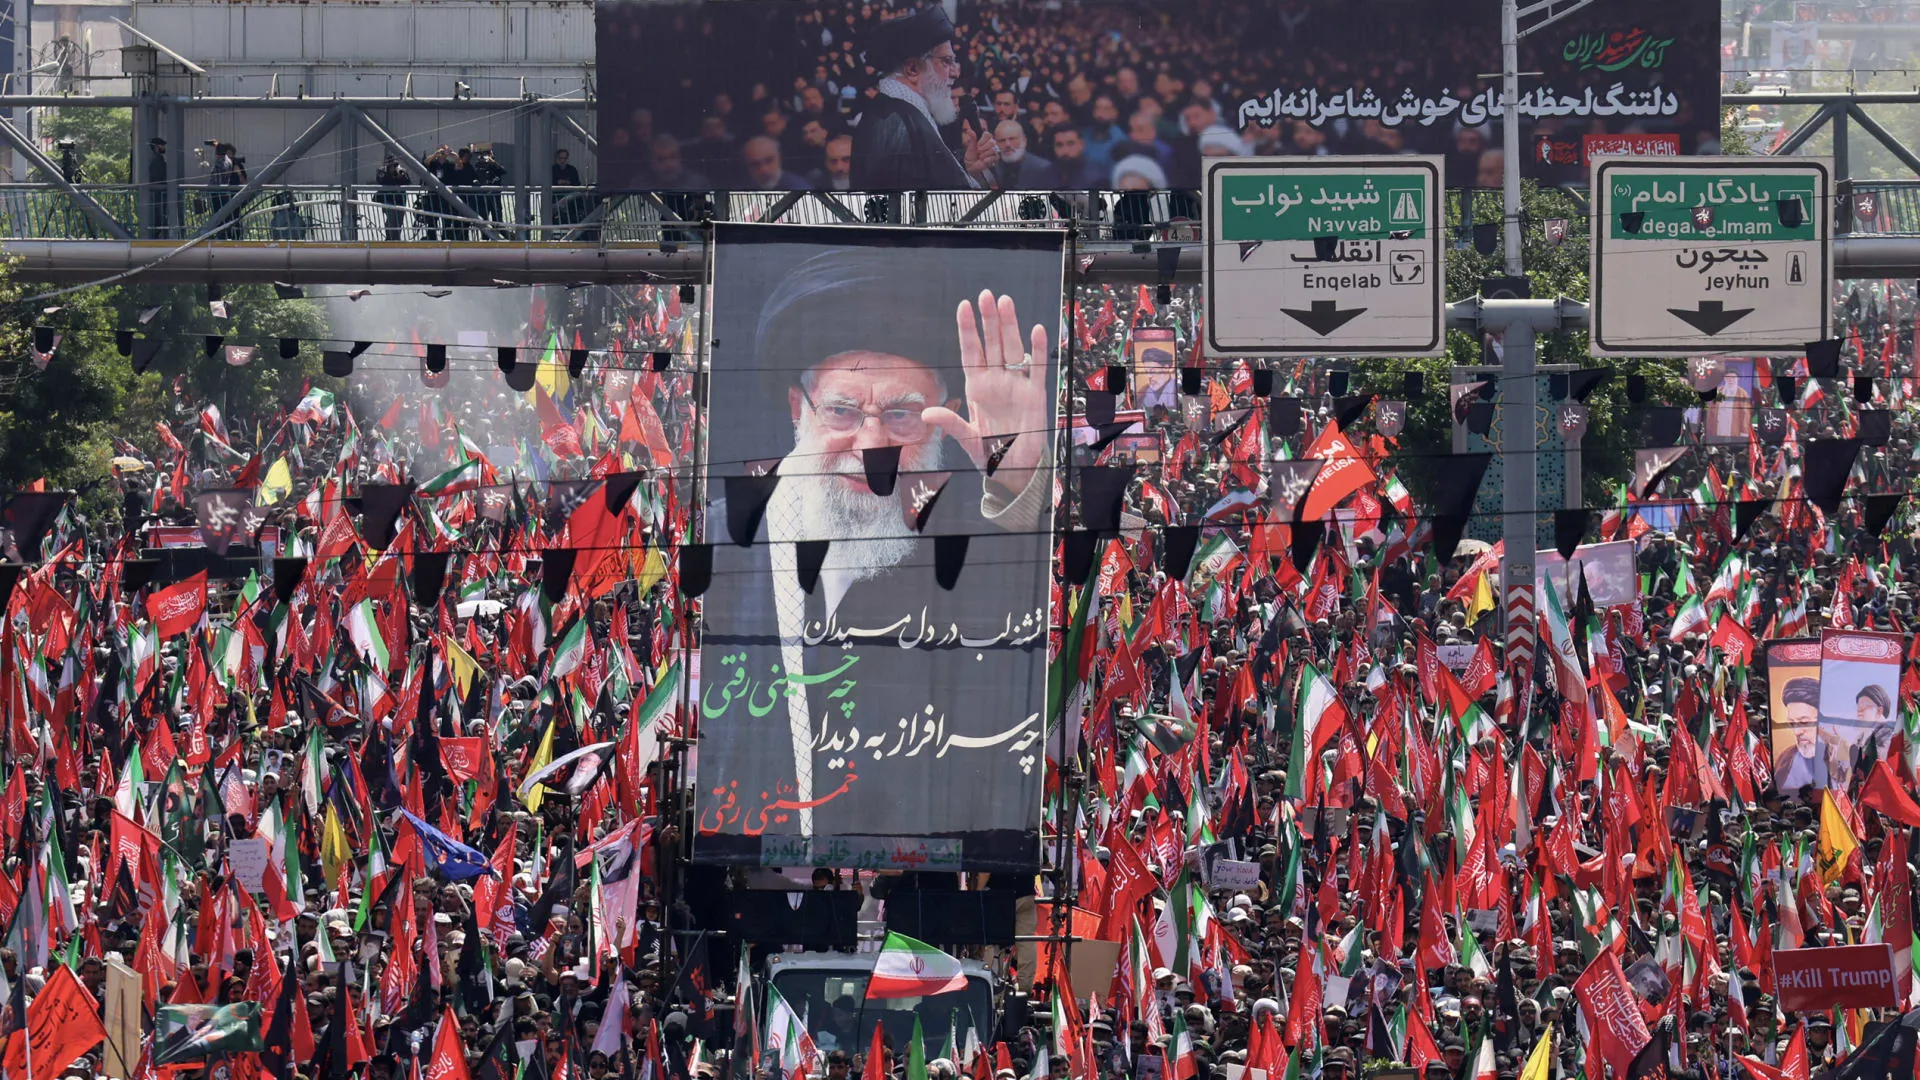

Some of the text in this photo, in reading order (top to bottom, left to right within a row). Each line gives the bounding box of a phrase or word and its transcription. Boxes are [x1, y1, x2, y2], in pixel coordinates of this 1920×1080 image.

[1563, 27, 1675, 72] آقای شهید ایران
[1382, 87, 1461, 126] خوش
[1593, 82, 1680, 117] دلتنگ
[1231, 179, 1381, 217] شهید نواب
[1632, 181, 1686, 213] امام
[1694, 179, 1771, 215] یادگار
[1308, 216, 1382, 233] Navvab
[1676, 248, 1770, 274] جیحون
[1303, 273, 1381, 291] Enqelab
[1705, 273, 1770, 291] Jeyhun
[1332, 455, 1357, 472] USA
[803, 605, 1043, 661] تشنه لب در دل میدان
[702, 651, 861, 720] چه حسینی رفتی
[810, 703, 1041, 776] چه سرافراز به دیدار
[699, 760, 860, 837] خمینی رفتی
[1779, 966, 1891, 989] #Kill Trump
